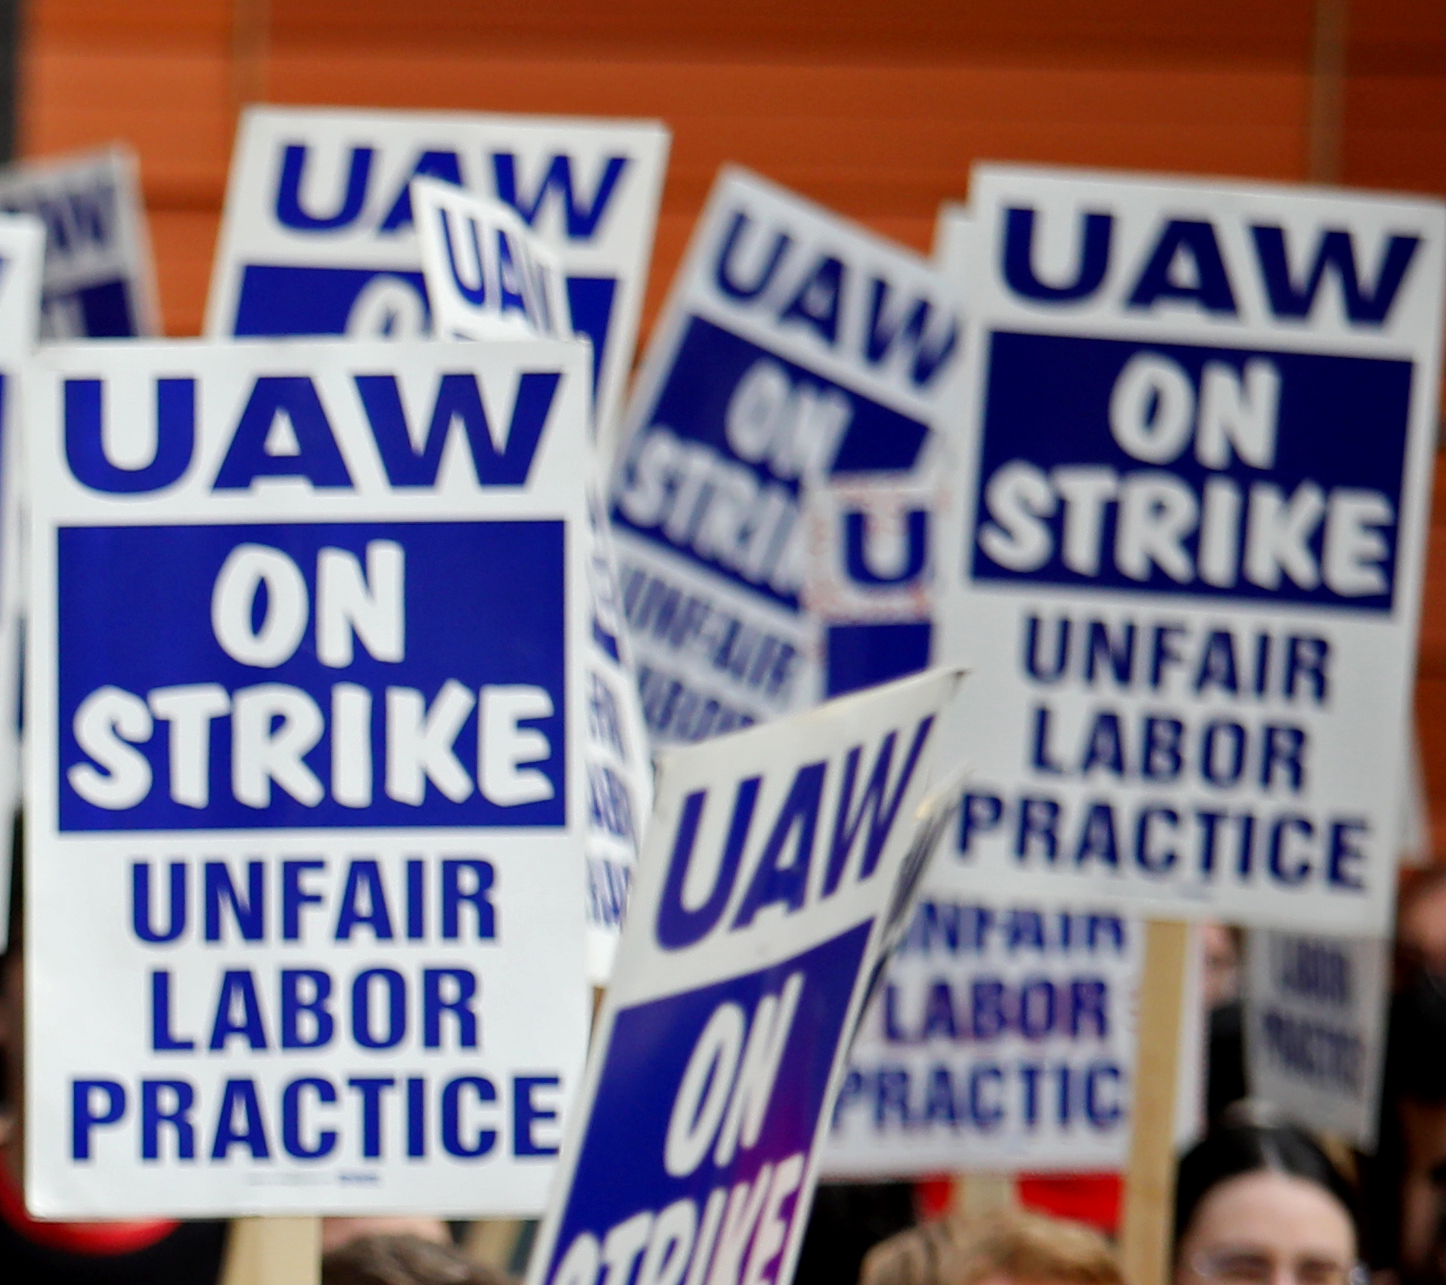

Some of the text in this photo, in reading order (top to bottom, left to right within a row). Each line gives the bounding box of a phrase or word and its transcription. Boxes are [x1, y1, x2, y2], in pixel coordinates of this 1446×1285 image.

[271, 143, 636, 242] UAW
[709, 210, 963, 388] UAW
[995, 206, 1427, 330] UAW
[61, 371, 563, 496] UAW
[721, 364, 859, 482] ON
[1106, 352, 1283, 470] ON
[623, 420, 811, 602] STRI
[975, 462, 1395, 600] STRIKE
[211, 538, 407, 670] ON
[1021, 613, 1333, 706] UNFAIR
[65, 680, 557, 812] STRIKE
[1027, 705, 1309, 796] LABOR
[655, 714, 941, 958] UAW
[957, 790, 1375, 893] PRACTICE
[128, 857, 499, 946] UNFAIR
[893, 902, 1129, 962] NFAIR
[148, 965, 481, 1054] LABOR
[879, 976, 1113, 1044] LABOR
[69, 1074, 561, 1166] PRACTICE
[665, 974, 805, 1180] ON
[841, 1064, 1129, 1138] PRACTIC
